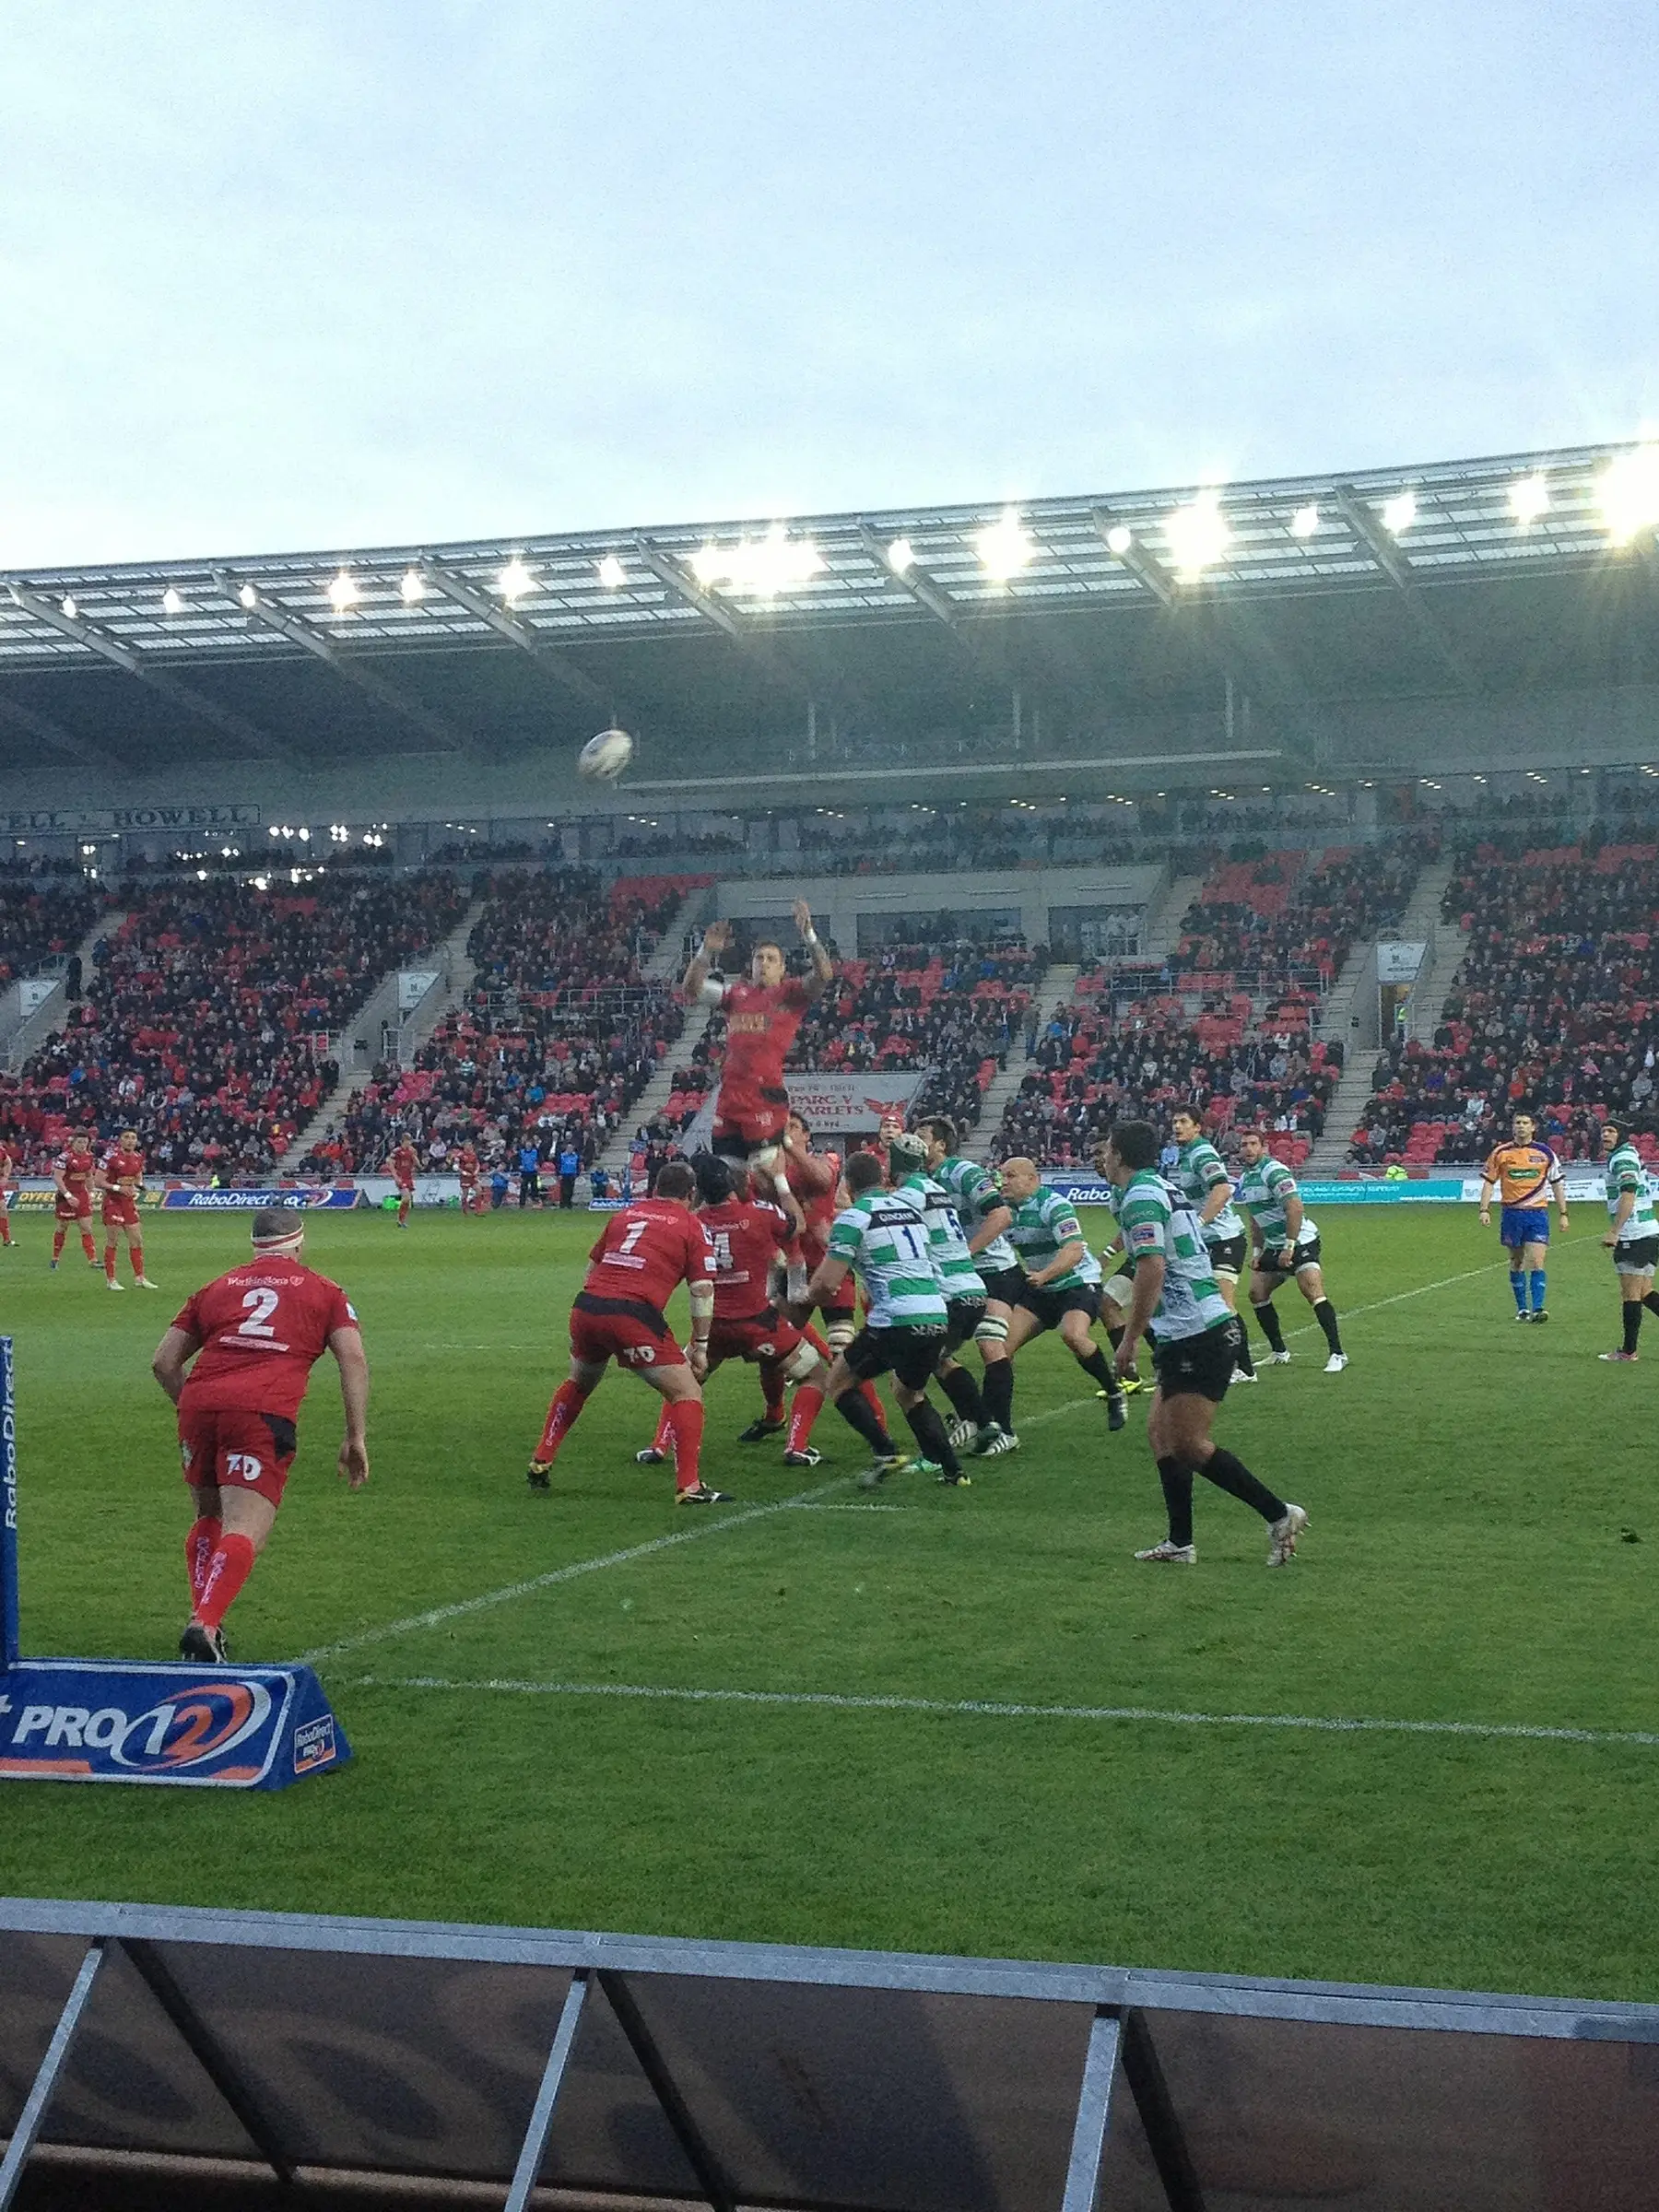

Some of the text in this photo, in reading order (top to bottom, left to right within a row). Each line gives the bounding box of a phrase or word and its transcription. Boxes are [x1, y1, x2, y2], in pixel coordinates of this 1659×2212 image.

[113, 806, 248, 828] HOWELL
[188, 1193, 267, 1206] RaboDirect
[619, 1220, 649, 1254] 1
[945, 1208, 964, 1241] 5
[901, 1226, 919, 1258] 1
[238, 1287, 279, 1336] 2
[2, 1341, 17, 1530] RaboDirect
